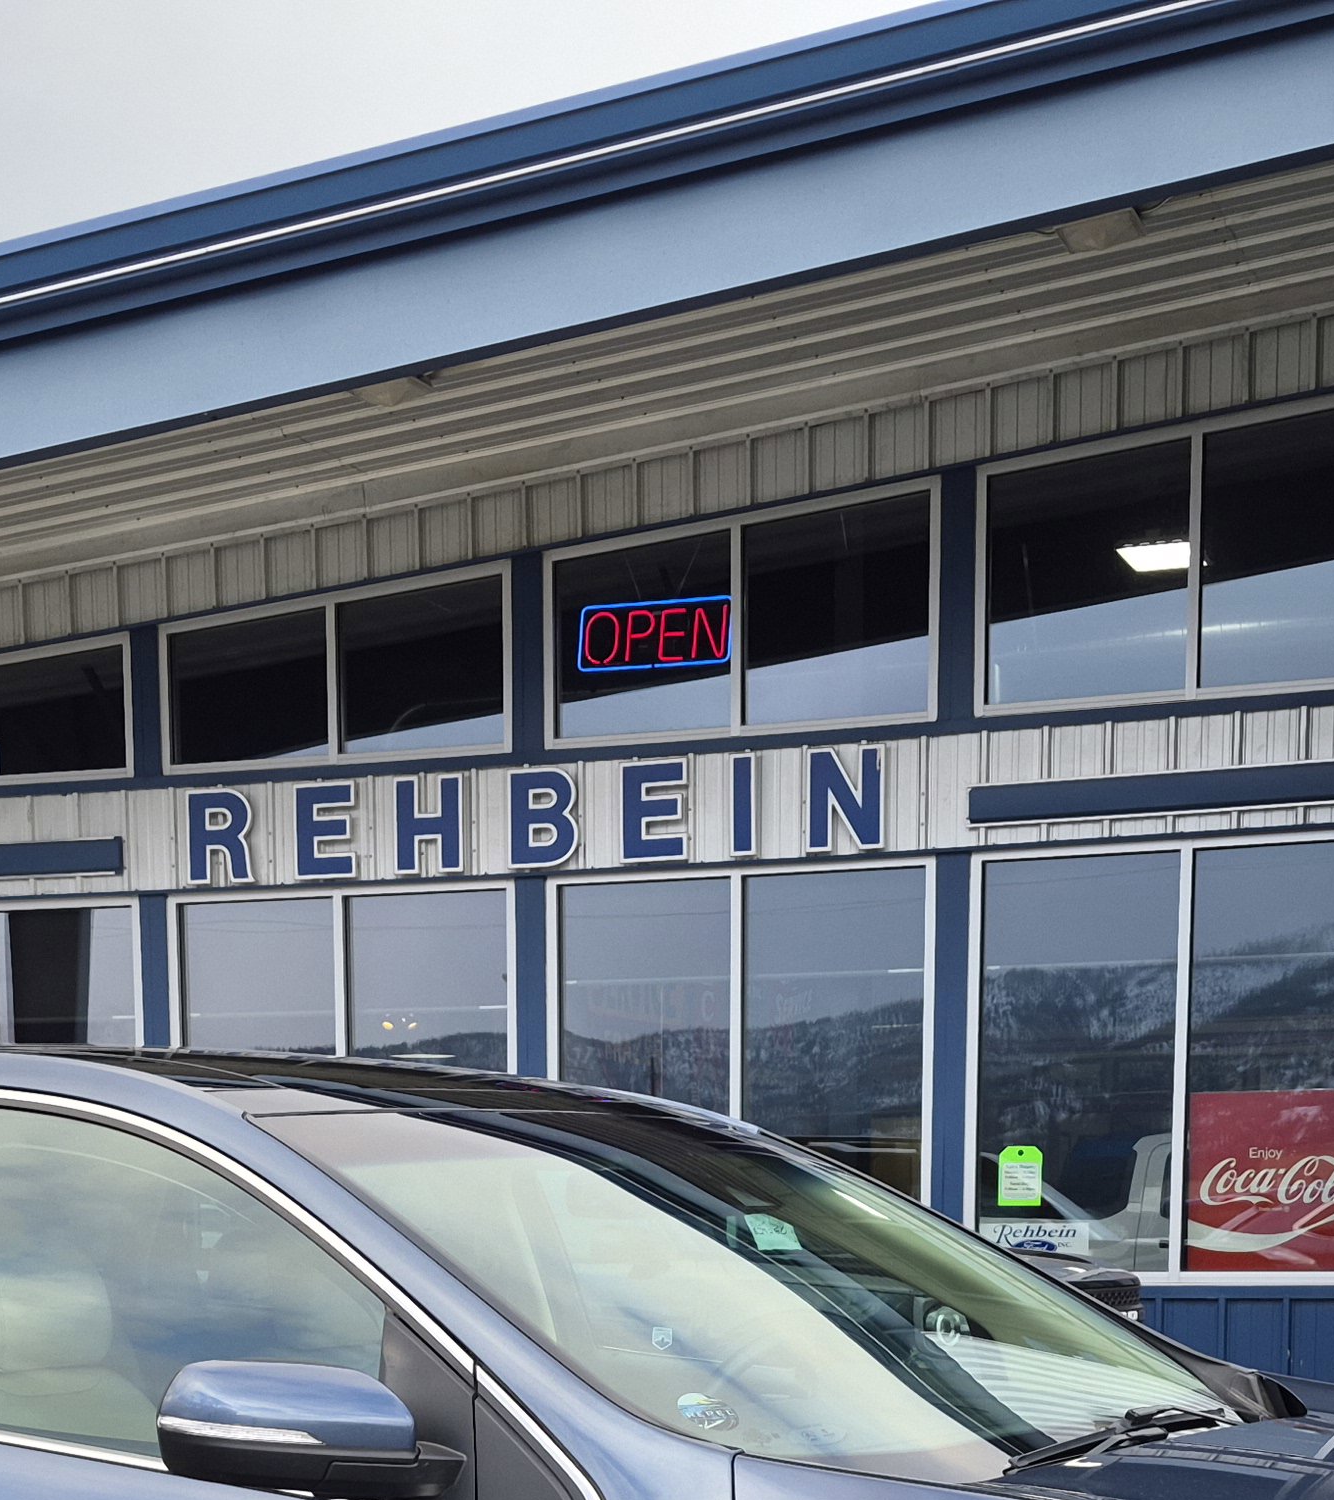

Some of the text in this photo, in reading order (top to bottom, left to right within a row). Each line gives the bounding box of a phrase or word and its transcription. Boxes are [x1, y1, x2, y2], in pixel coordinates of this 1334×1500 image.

[584, 604, 728, 665] OPEN
[185, 743, 886, 886] REHBEIN
[1249, 1147, 1283, 1160] Enjoy
[993, 1224, 1076, 1248] Rehbein
